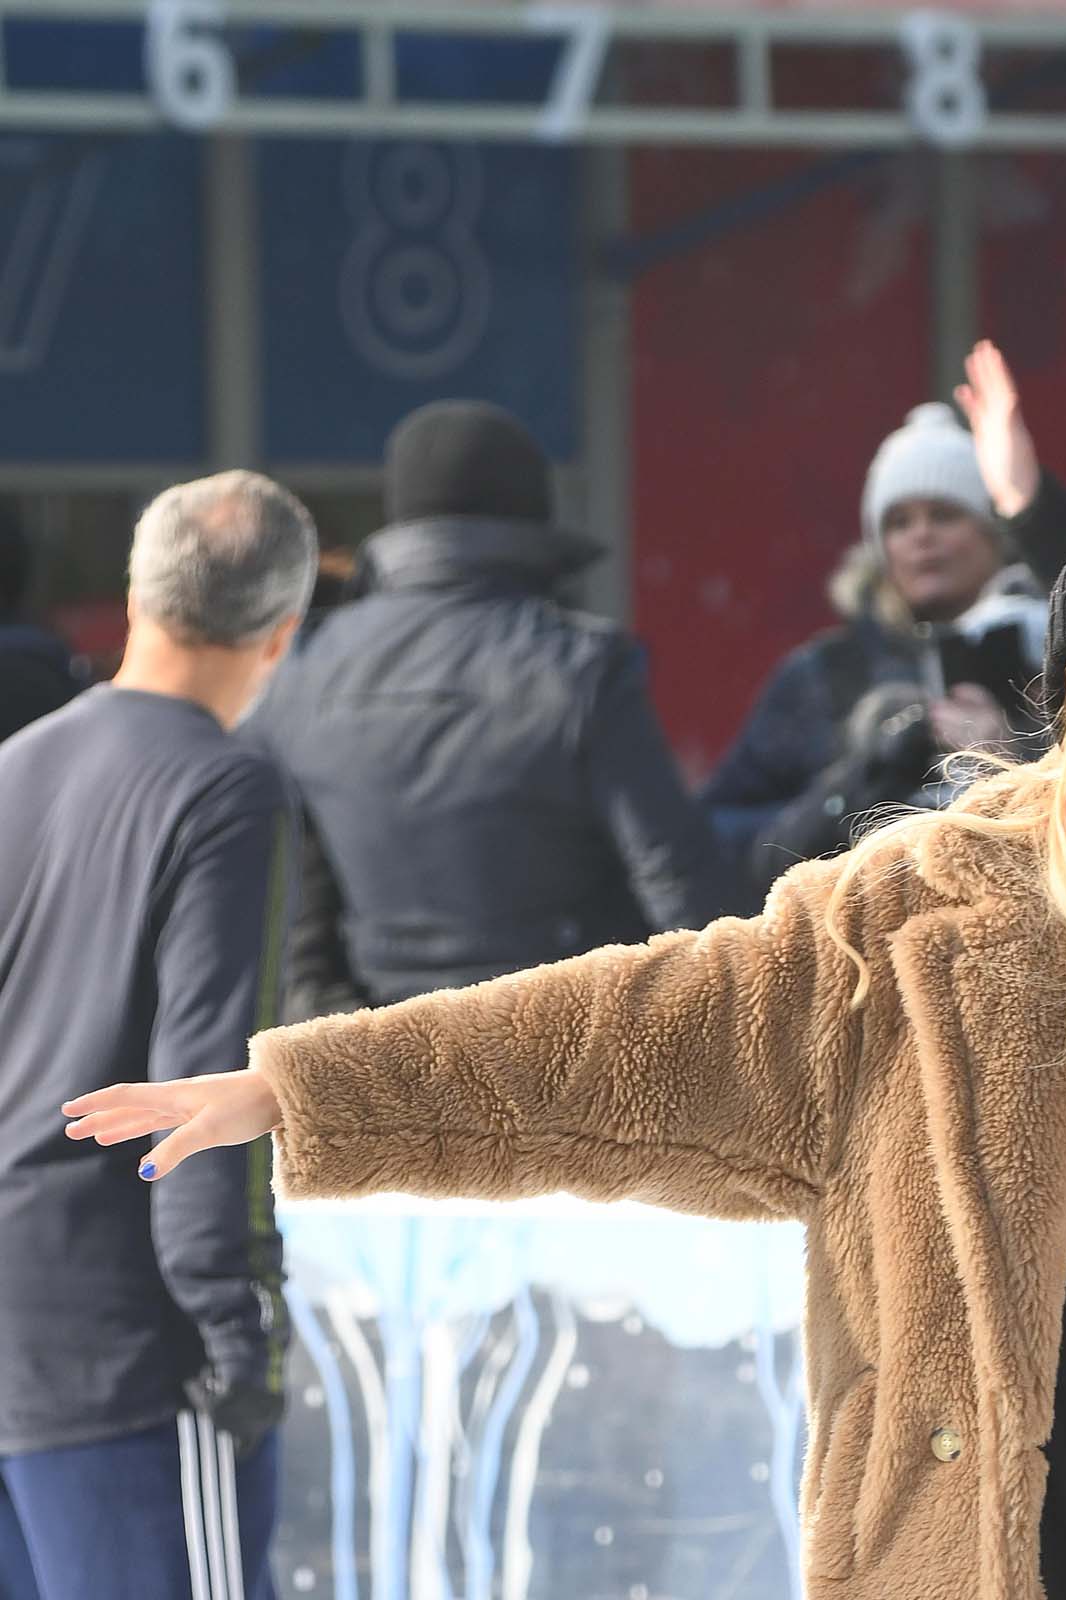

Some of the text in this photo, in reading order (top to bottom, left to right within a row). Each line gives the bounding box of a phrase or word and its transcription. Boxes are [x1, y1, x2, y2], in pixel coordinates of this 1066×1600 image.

[146, 0, 236, 130] 6
[526, 8, 612, 141] 7
[902, 12, 988, 148] 8
[338, 138, 492, 381] 8
